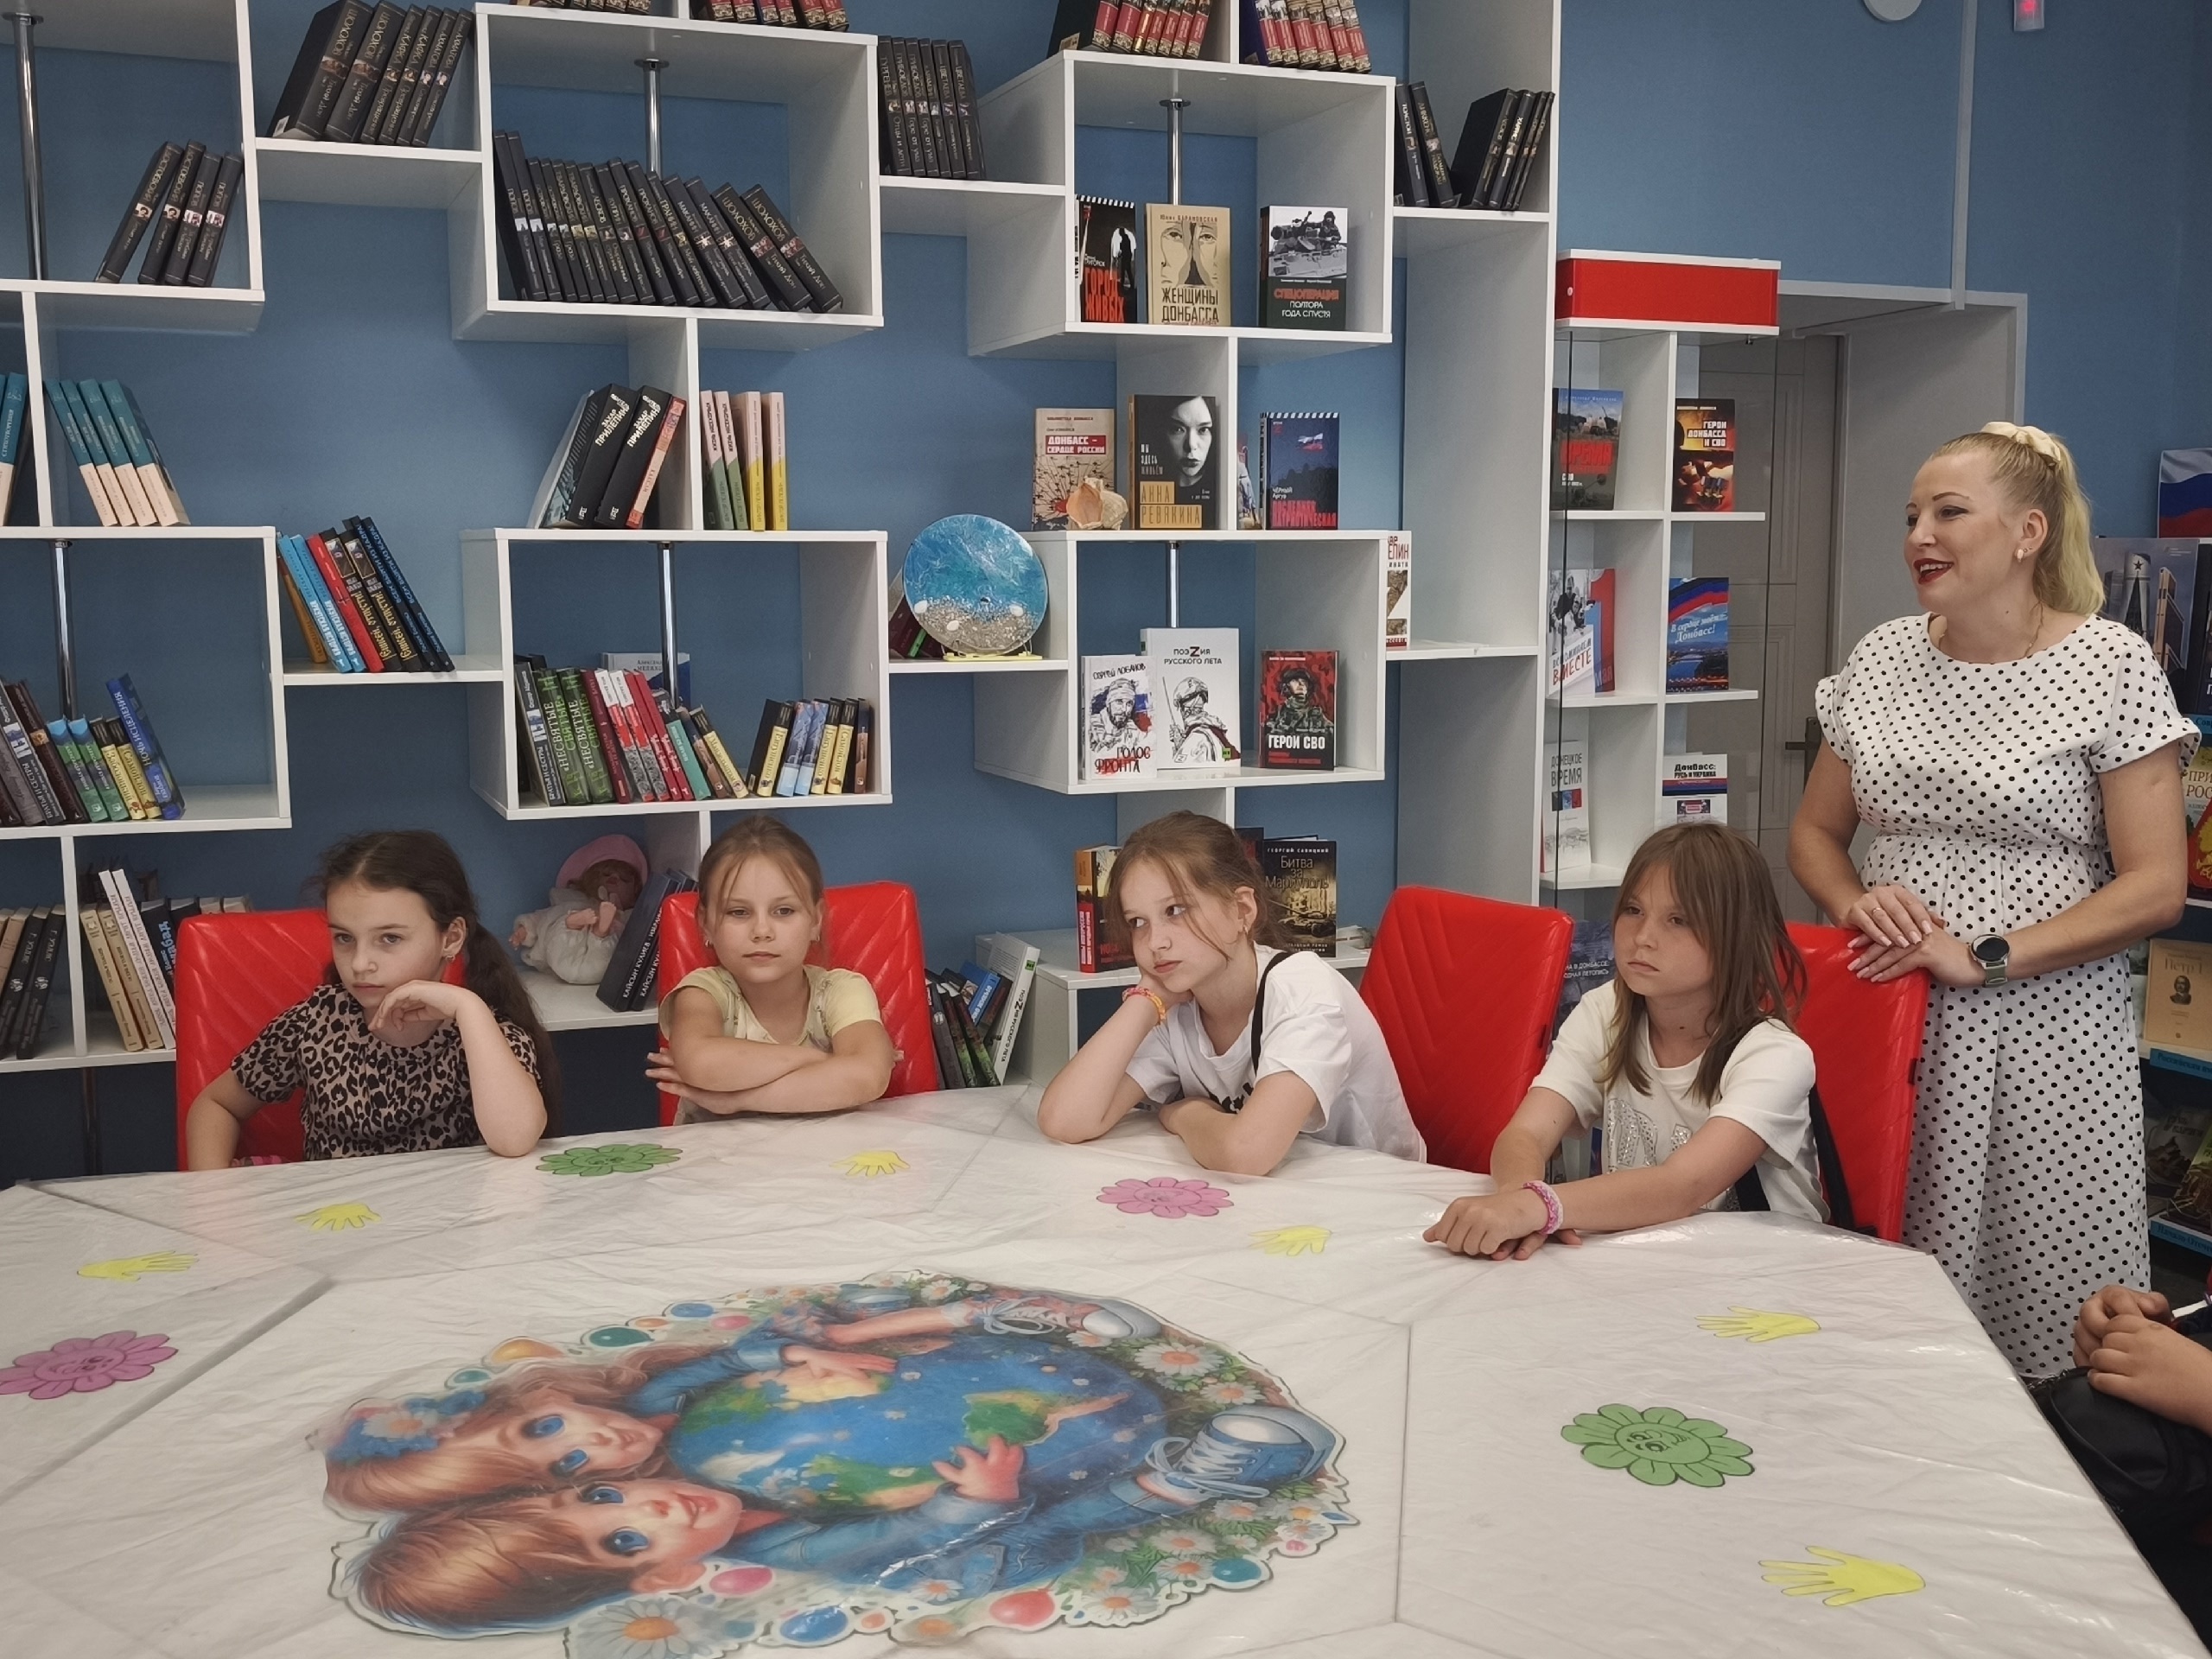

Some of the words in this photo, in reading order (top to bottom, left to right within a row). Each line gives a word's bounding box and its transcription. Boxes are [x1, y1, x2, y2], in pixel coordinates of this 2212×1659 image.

[331, 8, 357, 56] ШОЛОХОВ
[362, 10, 391, 60] ШОЛОХОВ
[391, 33, 411, 66] КАФКА
[410, 33, 429, 65] КАФКА
[506, 188, 519, 213] ПОПОВ
[522, 188, 533, 214] ПОПОВ
[619, 184, 639, 222] ПРОХАНОВ
[637, 187, 658, 225] ПРОХАНОВ
[721, 195, 757, 241] ШОЛОХОВ
[750, 197, 786, 242] ШОЛОХОВ
[1084, 267, 1119, 296] ГОРОД
[1085, 294, 1125, 322] ЖИВЫХ
[1161, 288, 1218, 306] ЖЕНЩИНЫ
[1161, 306, 1219, 322] ДОНБАССА
[595, 407, 629, 446] ПРИЛЕПИН
[601, 409, 616, 428] ЗАХАР
[627, 408, 660, 448] ПРИЛЕПИН
[633, 410, 648, 429] ЗАХАР
[1048, 436, 1089, 445] ДОНБАСС
[1688, 429, 1726, 438] ДОНБАССА
[1141, 455, 1158, 465] ЗДЕСЬ
[1141, 485, 1170, 503] АННА
[1141, 505, 1200, 524] РЕВЯКИНА
[388, 584, 402, 603] ВСЕМ
[402, 584, 415, 603] ВСЕМ
[1671, 624, 1676, 632] В
[1677, 620, 1700, 632] сердце
[1675, 624, 1716, 645] Донбасс!
[1117, 663, 1146, 677] ЛОБАНОВ
[1553, 647, 1591, 685] ВМЕСТЕ
[113, 690, 142, 741] ИСЦЕЛЕНИЯ
[553, 694, 575, 751] СВЯТЫЕ»
[577, 692, 600, 748] СВЯТЫЕ»
[543, 701, 569, 772] «НЕСВЯТЫЕ
[568, 699, 594, 769] «НЕСВЯТЫЕ
[1268, 734, 1300, 749] ГЕРОИ
[1303, 736, 1325, 749] СВО
[134, 741, 151, 766] НОЧЬ
[536, 745, 548, 772] СЕСТРЫ
[709, 737, 737, 782] Мандельштам
[763, 733, 783, 779] Евтушенко
[816, 730, 832, 777] Евтушенко
[834, 731, 849, 772] Самойлов
[1116, 747, 1152, 759] ГОЛОС
[22, 761, 39, 789] СЕСТРЫ
[105, 750, 134, 801] Заболоцкий
[122, 749, 149, 796] Самойлов
[1094, 759, 1141, 772] ФРОНТА
[1675, 764, 1716, 772] Донбасс:
[544, 778, 556, 800] БРАТЬЯ
[36, 793, 54, 819] БРАТЬЯ
[1281, 855, 1313, 868] Битва
[1290, 868, 1304, 878] за
[1265, 875, 1330, 891] Мариуполь
[623, 969, 639, 998] КАЙСЫН
[636, 942, 651, 968] КУЛИЕВ
[2164, 957, 2195, 975] Петр
[640, 968, 656, 996] КАЙСЫН
